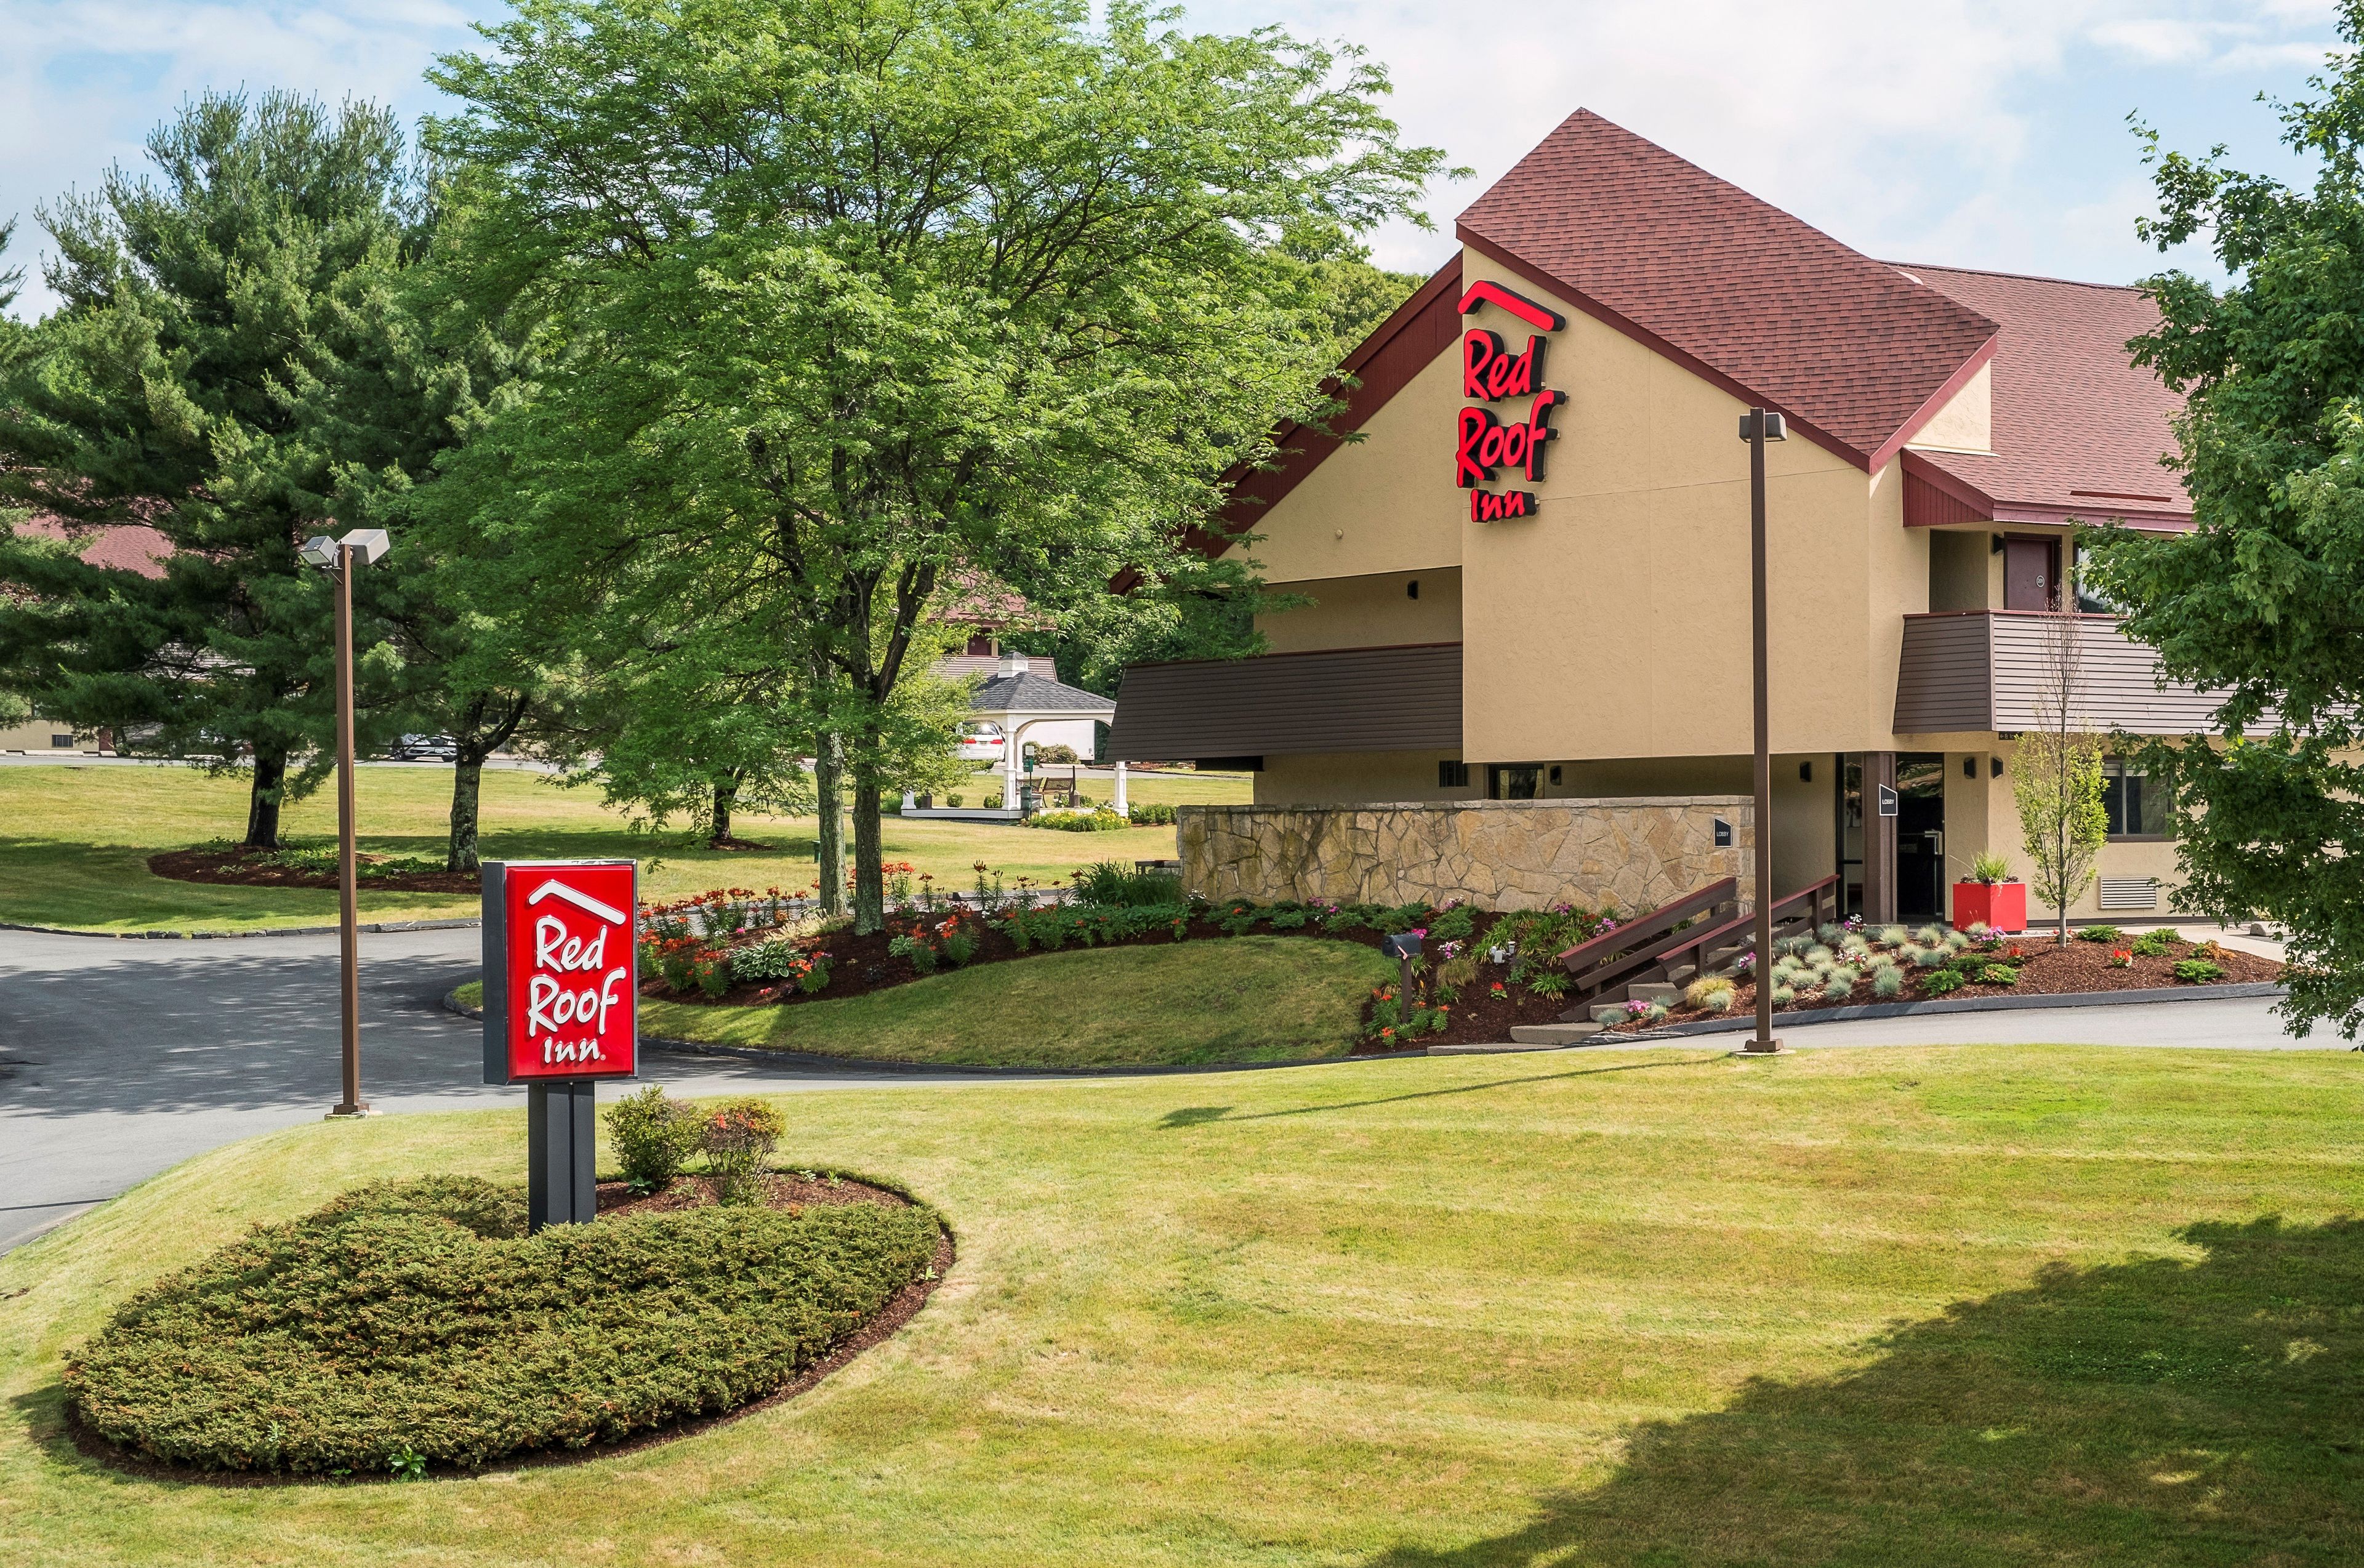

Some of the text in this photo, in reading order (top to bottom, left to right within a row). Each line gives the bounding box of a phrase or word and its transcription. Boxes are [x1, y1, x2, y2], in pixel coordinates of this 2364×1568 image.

[1463, 328, 1537, 401] Red
[1455, 390, 1556, 488] Roof
[1470, 488, 1526, 523] Inn
[536, 915, 608, 973] Red
[528, 967, 627, 1037] Roof
[544, 1037, 600, 1064] Inn
